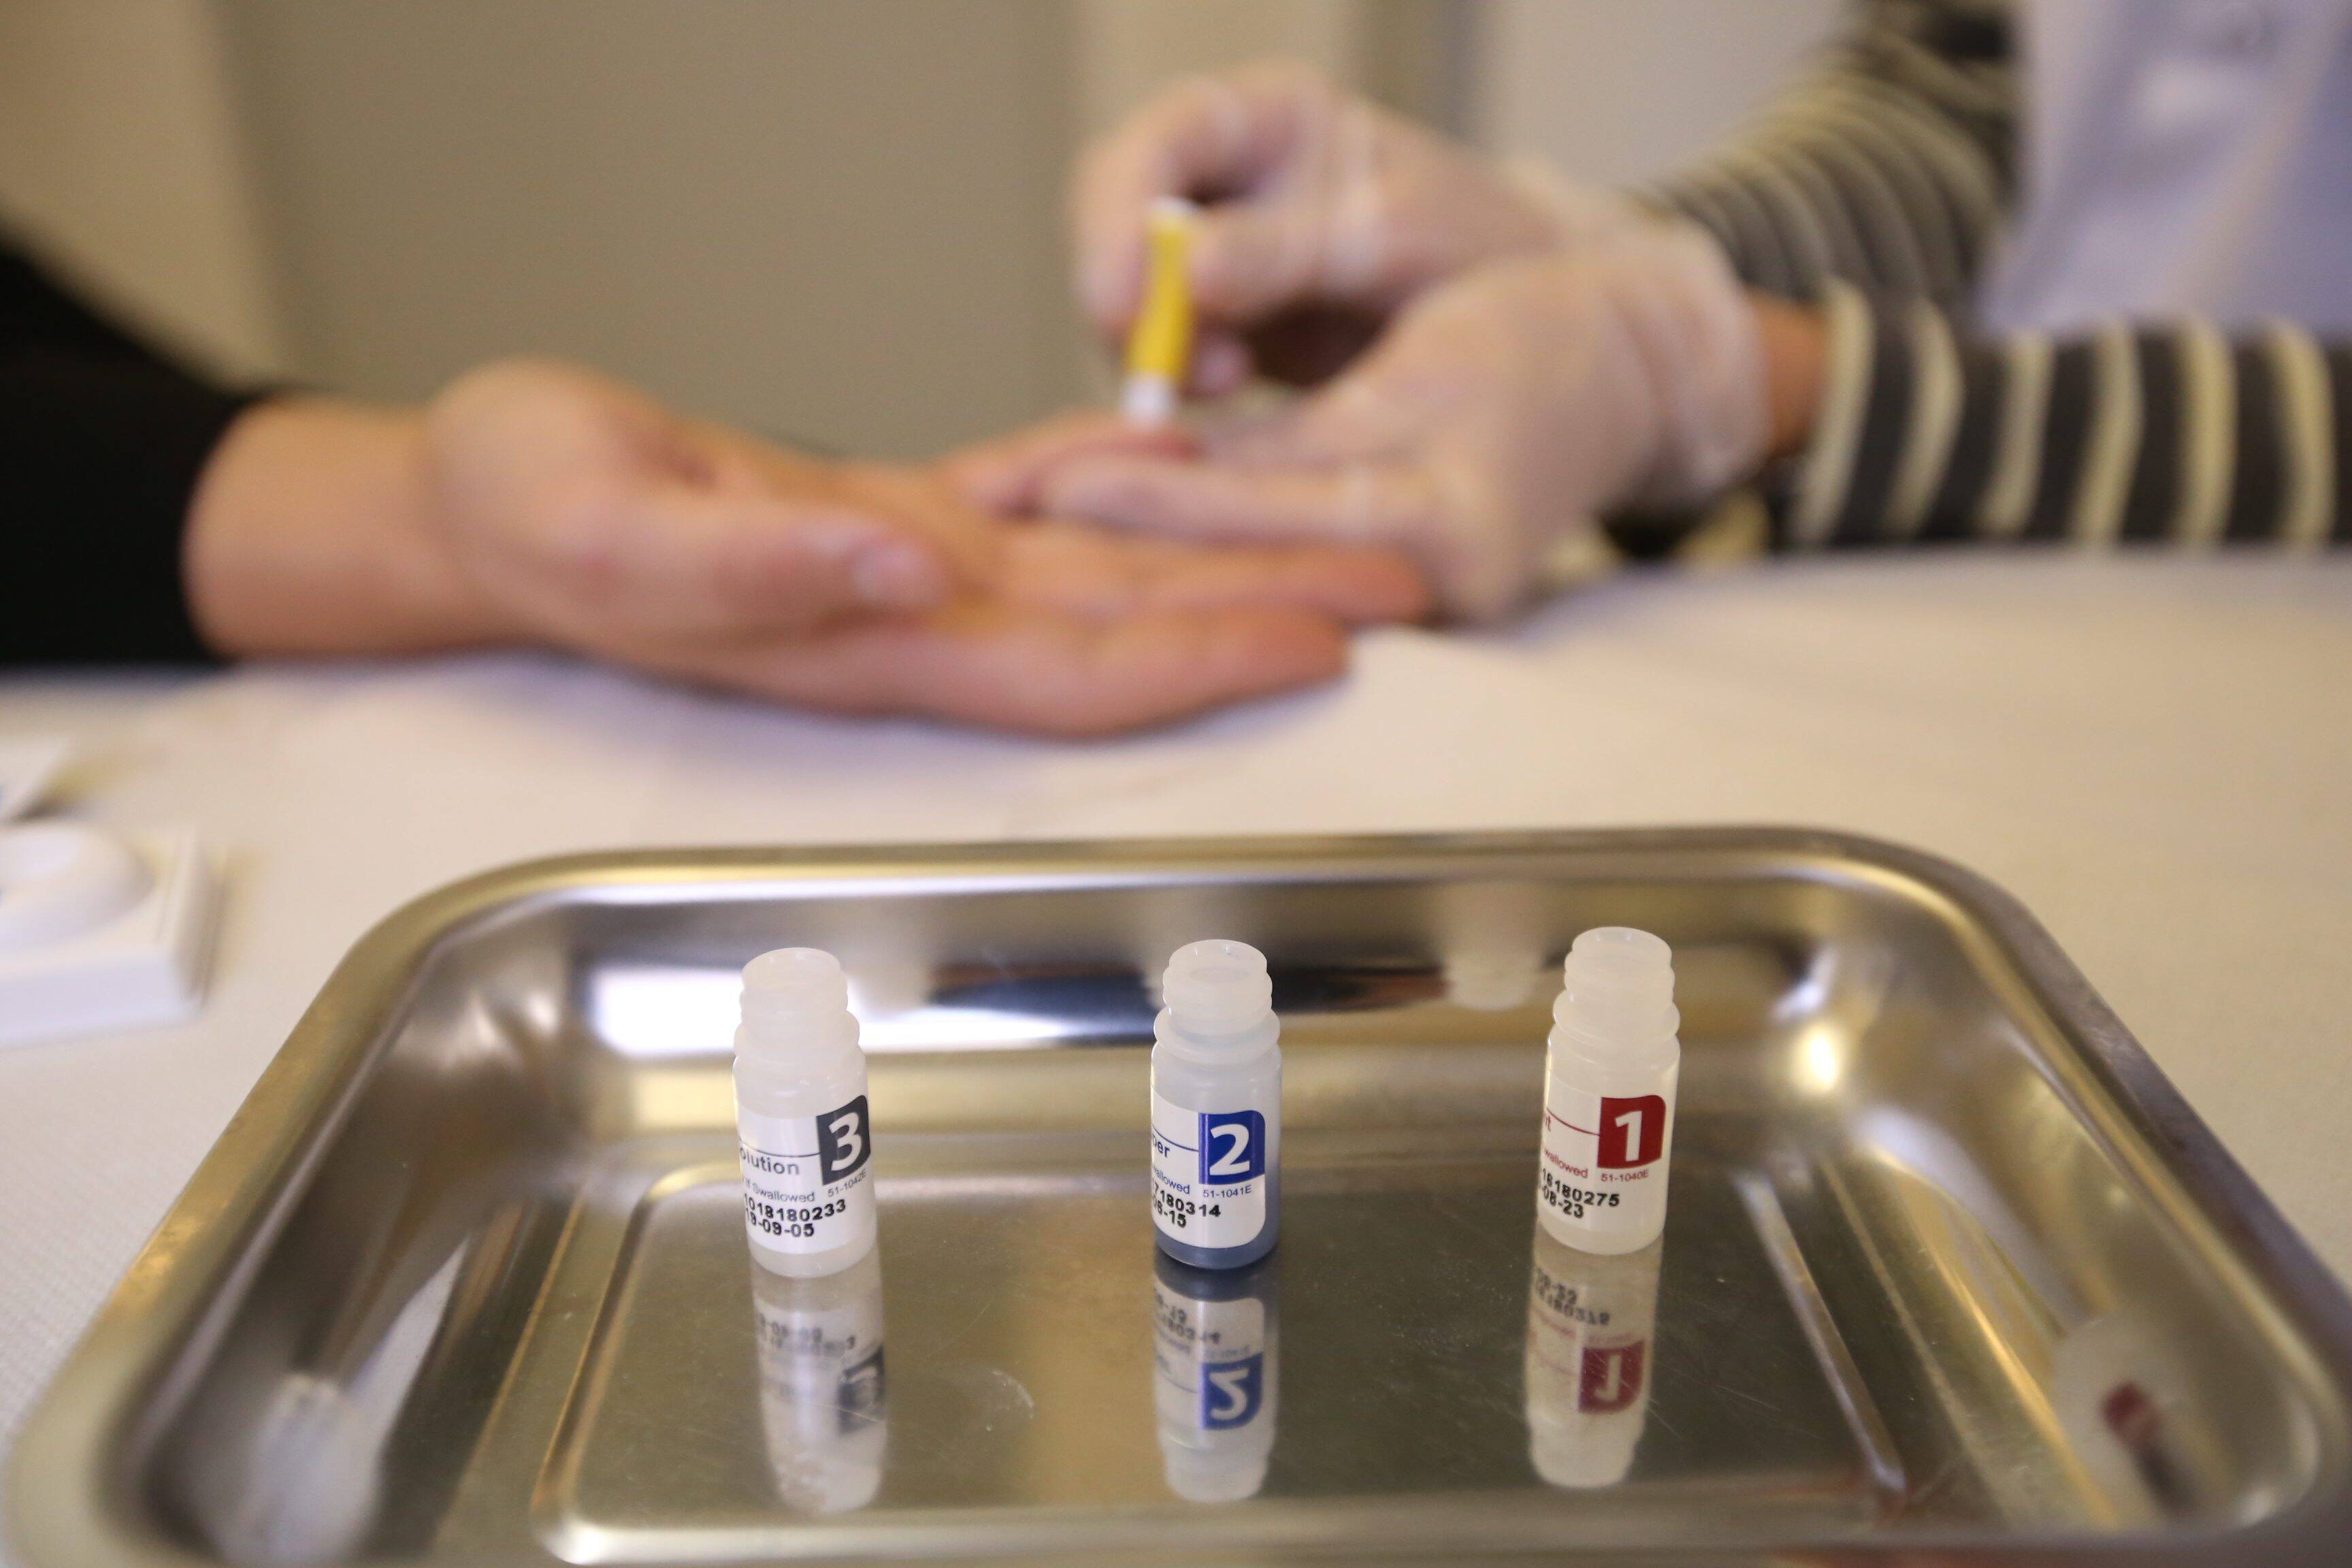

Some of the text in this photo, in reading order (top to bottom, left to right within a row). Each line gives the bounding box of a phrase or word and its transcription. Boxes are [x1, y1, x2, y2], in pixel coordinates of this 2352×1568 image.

[828, 1111, 862, 1171] 3
[1209, 1124, 1250, 1176] 2
[1614, 1110, 1643, 1162] 1
[828, 1169, 866, 1198] 51-1042E
[1601, 1169, 1650, 1183] 51-1040E
[752, 1183, 815, 1203] Swallowed
[1203, 1185, 1252, 1198] 51-1041E
